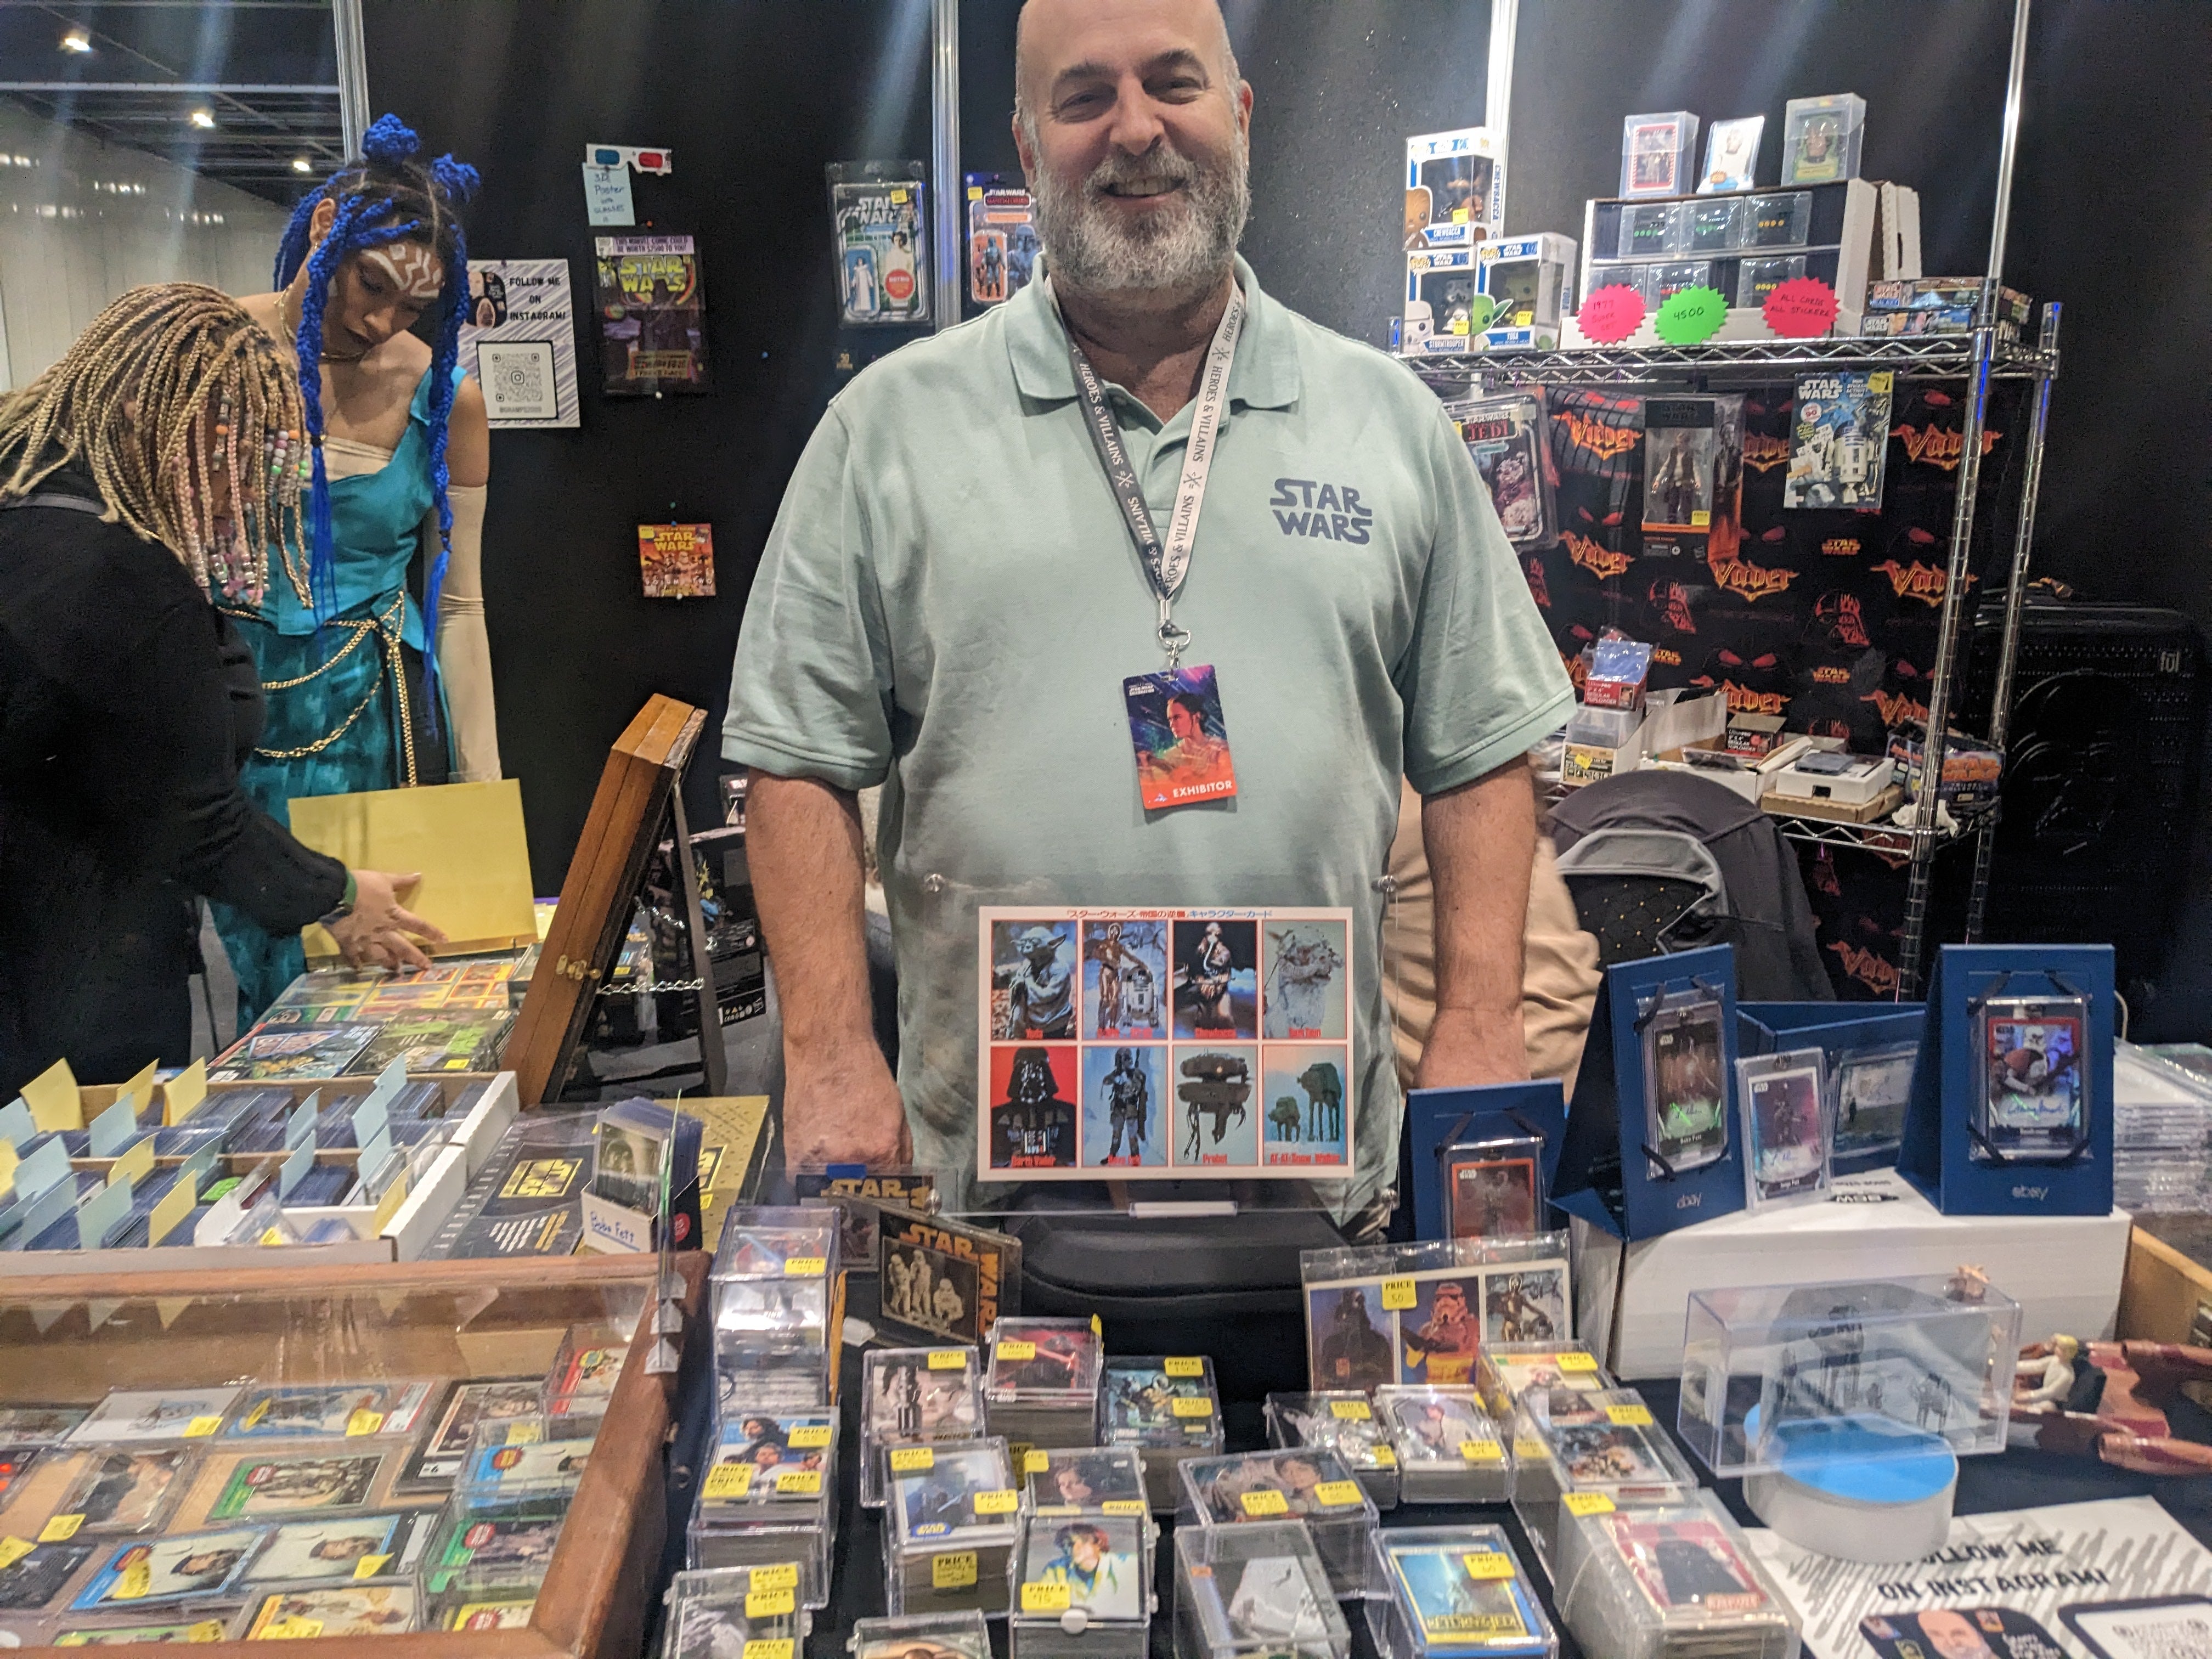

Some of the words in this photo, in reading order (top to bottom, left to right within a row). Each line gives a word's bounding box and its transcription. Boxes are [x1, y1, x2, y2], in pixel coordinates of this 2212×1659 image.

[620, 256, 685, 274] STAR
[510, 277, 544, 286] FOLLOW
[548, 276, 561, 285] ME
[621, 274, 686, 292] WAS
[529, 295, 541, 303] ON
[1780, 294, 1796, 302] ALL
[1673, 307, 1705, 320] 4500
[1770, 305, 1787, 313] ALL
[1223, 305, 1240, 341] HEROES
[1080, 363, 1102, 404] HEROES
[1205, 366, 1223, 403] HEROES
[1799, 379, 1843, 390] STAR
[1798, 388, 1843, 400] WARS
[1093, 405, 1105, 416] &
[1204, 403, 1214, 413] &
[1193, 413, 1214, 463] VILLAINS
[1468, 420, 1509, 440] JEDI
[1098, 415, 1124, 466] VILLAINS
[1270, 478, 1372, 517] STAR
[1127, 496, 1154, 545] VILLAINS
[1174, 495, 1195, 543] VILLAINS
[1272, 510, 1373, 545] WARS
[653, 532, 697, 541] STAR
[1823, 539, 1859, 548] STAR
[654, 541, 696, 551] WARS
[1173, 544, 1183, 552] &
[1822, 546, 1861, 556] WARS
[1173, 780, 1233, 798] EXHIBITOR
[820, 1179, 909, 1198] STAR
[2012, 1185, 2049, 1201] ebay
[1677, 1193, 1702, 1209] ebay
[590, 1211, 611, 1232] Boba
[615, 1221, 634, 1243] Fett
[900, 1222, 979, 1261] STAR
[1386, 1280, 1412, 1290] PRICE
[938, 1555, 972, 1566] PRICE
[1905, 1542, 2009, 1567] LLOW
[2016, 1538, 2063, 1556] ME
[752, 1590, 790, 1601] PRICE
[1029, 1584, 1065, 1593] PRICE
[1877, 1582, 1921, 1601] ON
